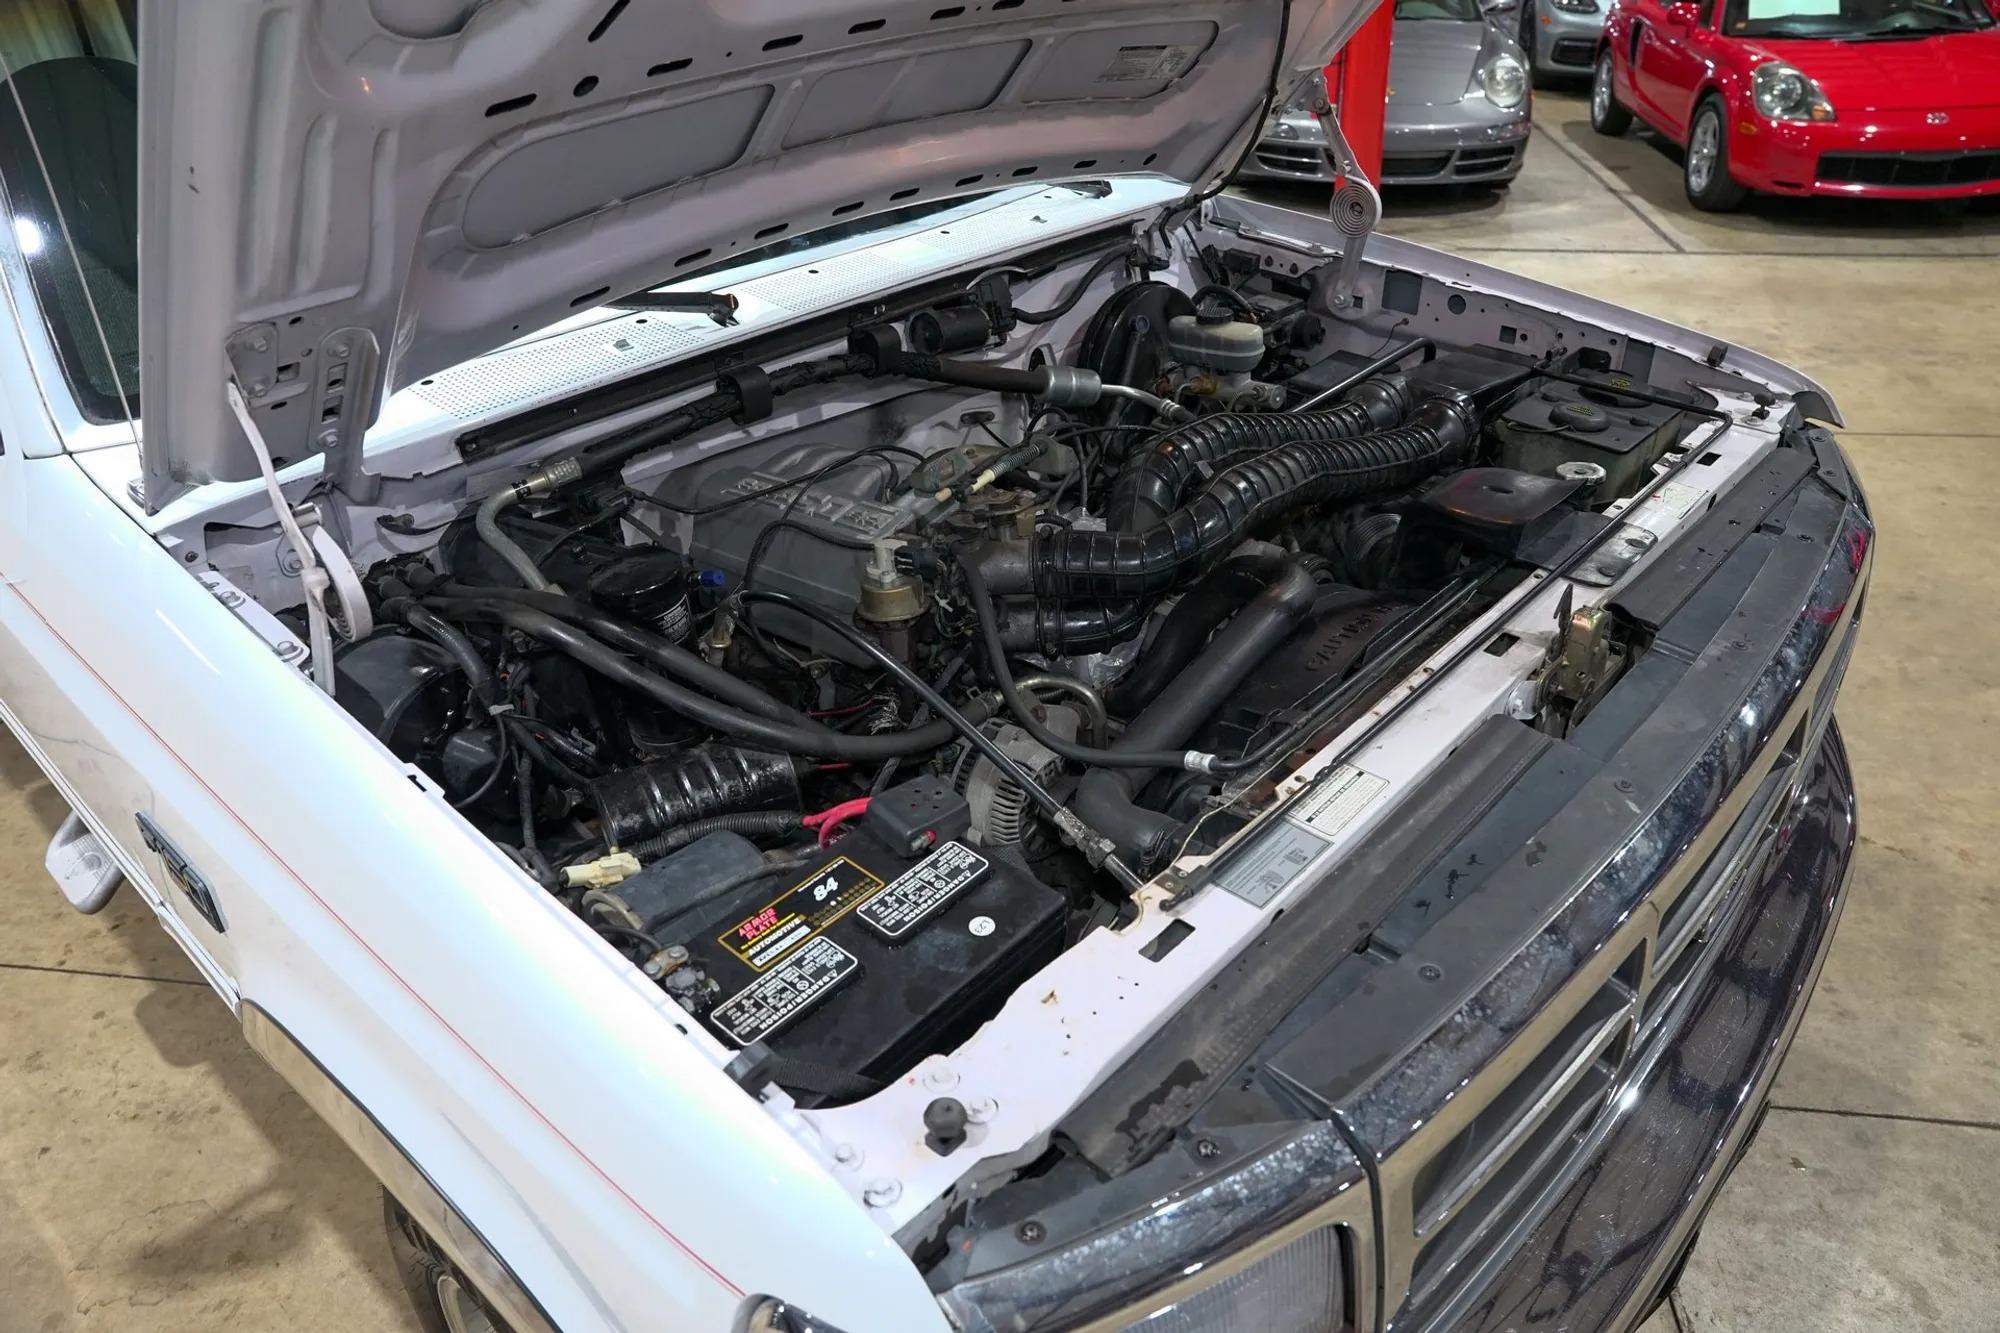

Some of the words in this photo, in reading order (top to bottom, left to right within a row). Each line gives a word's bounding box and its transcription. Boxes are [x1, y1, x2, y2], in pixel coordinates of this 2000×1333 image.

[812, 876, 839, 902] 84
[903, 875, 966, 922] DANGER/POISON
[738, 907, 776, 937] ARMOR
[745, 916, 778, 940] PLATE
[748, 918, 802, 957] AUTOMOTIVE
[758, 975, 831, 1030] DANGER/POISON
